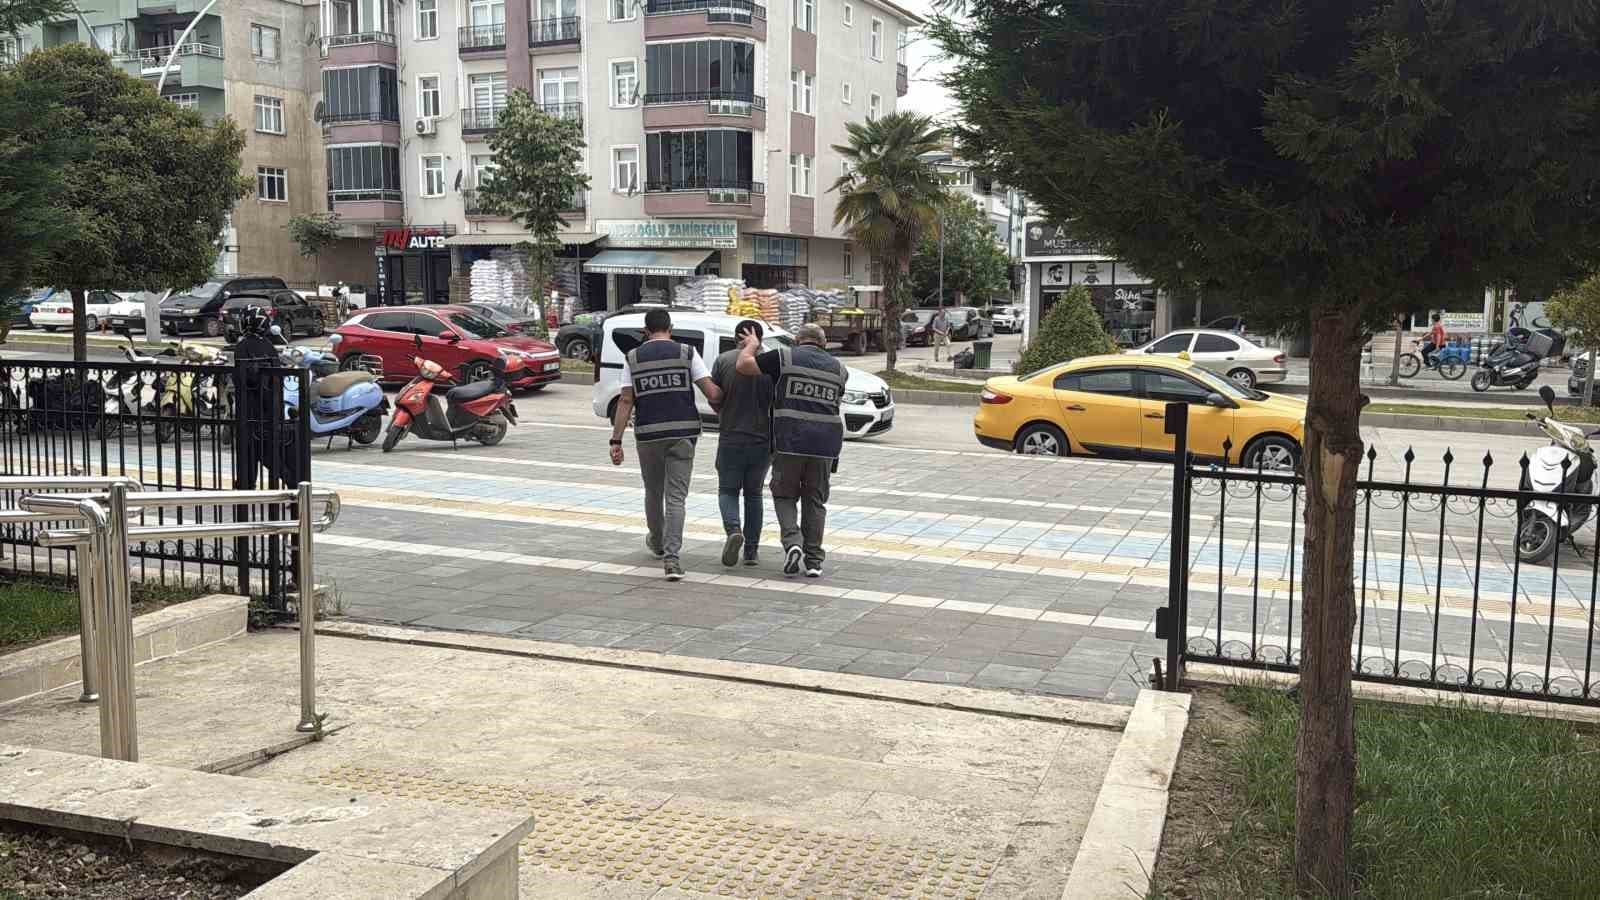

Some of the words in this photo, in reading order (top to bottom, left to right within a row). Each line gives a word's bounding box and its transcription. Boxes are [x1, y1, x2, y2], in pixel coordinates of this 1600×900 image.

[409, 236, 446, 249] AUTO
[639, 374, 682, 391] POLIS
[793, 382, 835, 401] POLIS
